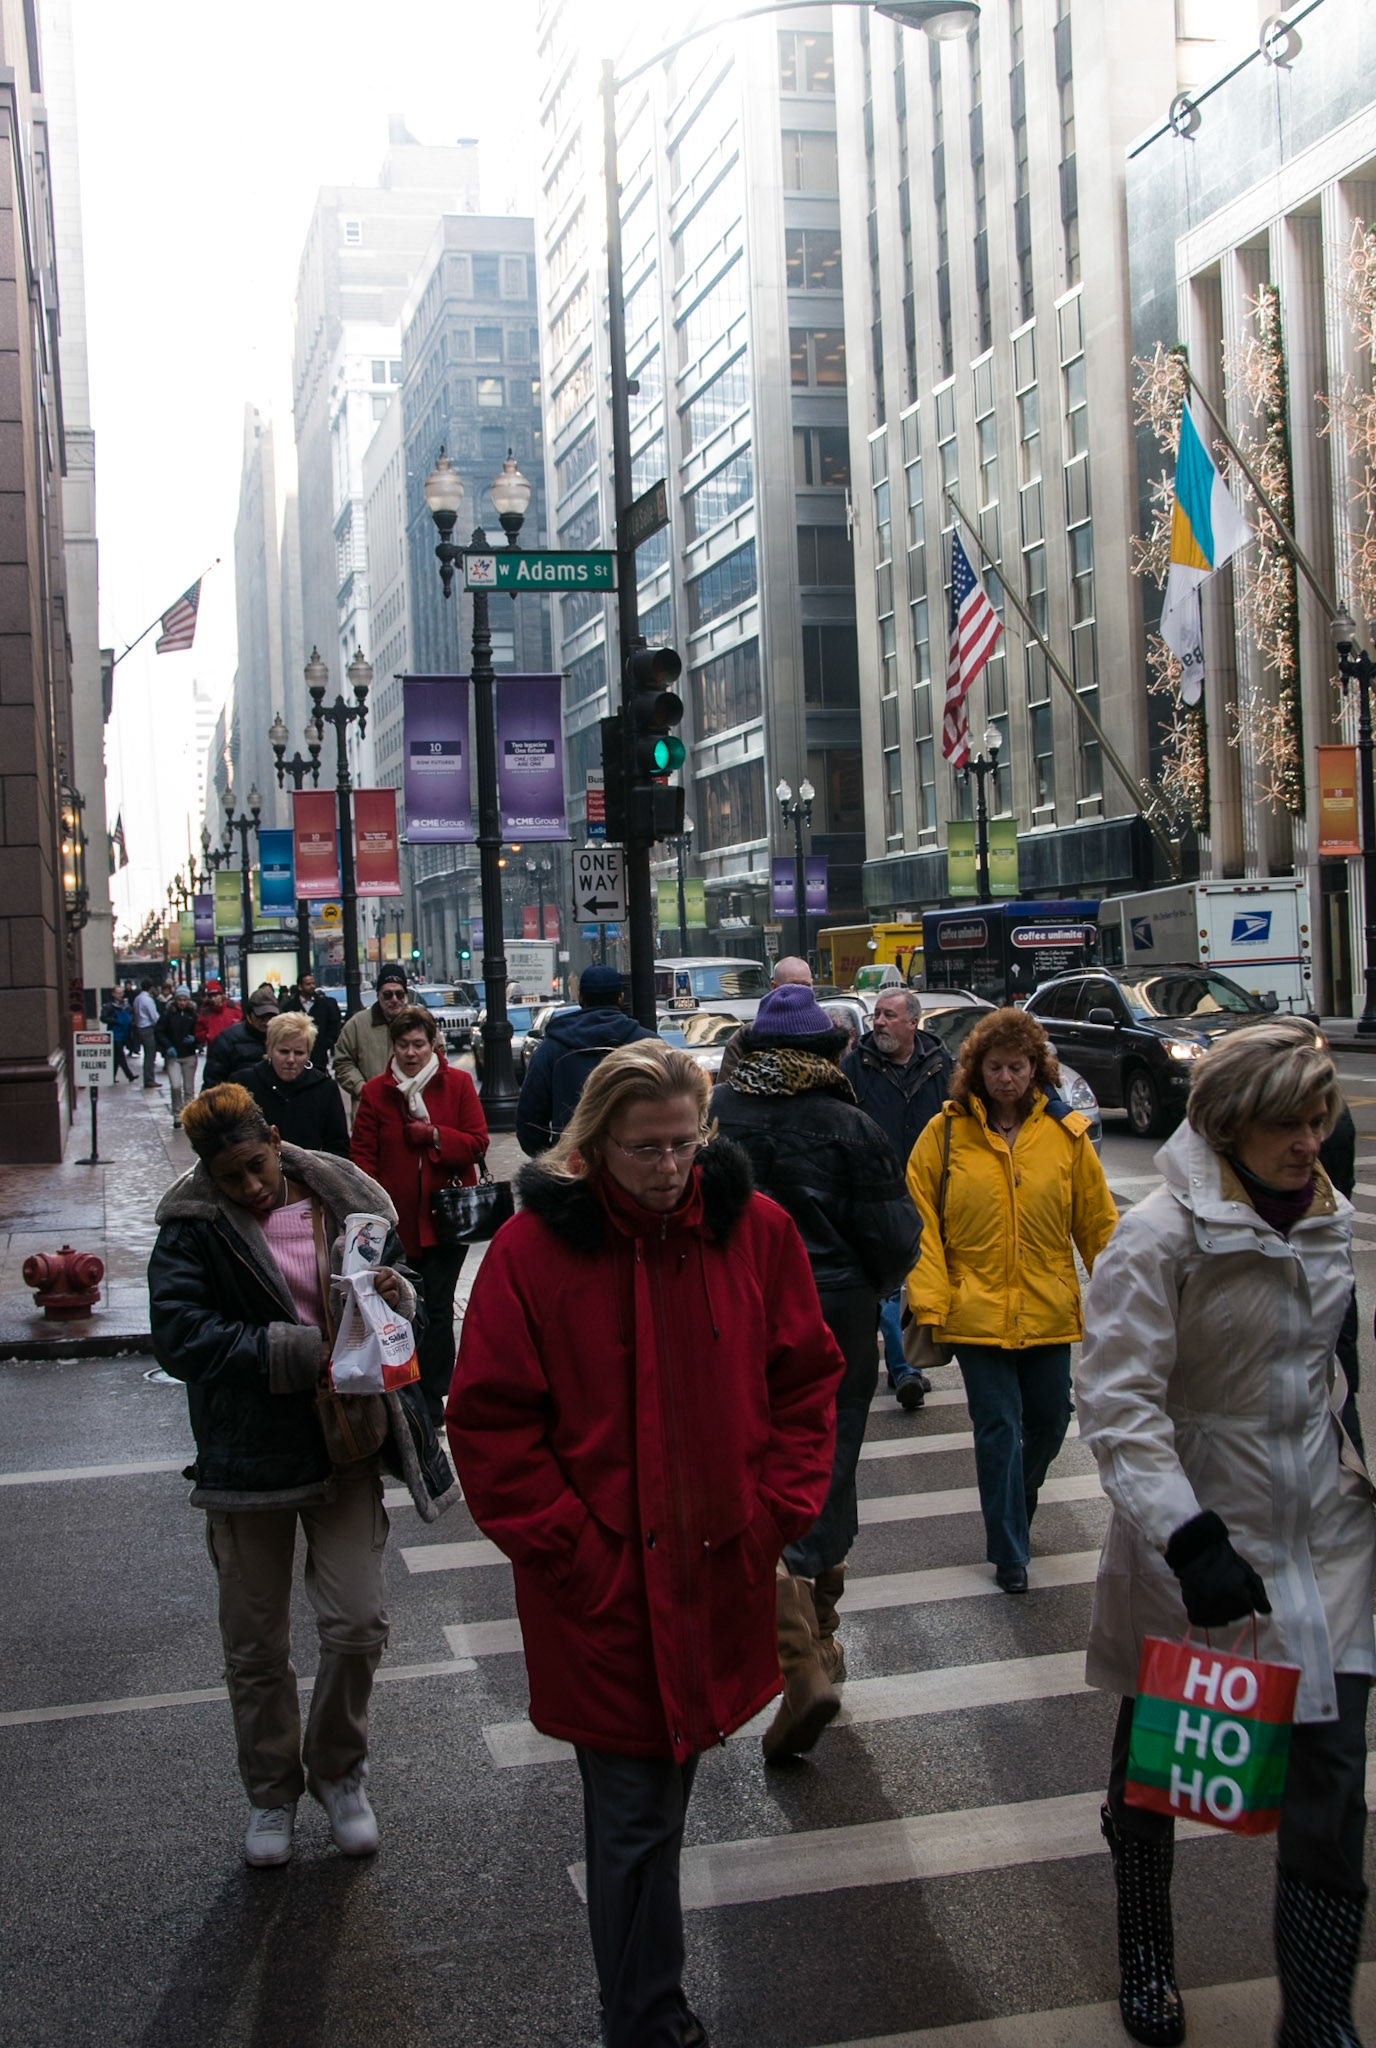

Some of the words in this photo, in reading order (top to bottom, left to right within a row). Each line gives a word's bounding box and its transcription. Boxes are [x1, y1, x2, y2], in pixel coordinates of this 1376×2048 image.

[517, 560, 588, 581] Adams
[594, 566, 608, 576] St
[430, 743, 441, 751] 10
[420, 819, 439, 827] CME
[535, 818, 559, 826] Group
[580, 855, 617, 871] ONE
[579, 875, 618, 891] WAY
[1018, 931, 1046, 940] coffee
[1048, 930, 1083, 939] unlimite
[77, 1049, 98, 1057] WATCH
[99, 1049, 111, 1057] FOR
[81, 1061, 106, 1069] FALLING
[89, 1073, 99, 1081] ICE
[1183, 1656, 1258, 1712] HO
[1174, 1709, 1250, 1767] HO
[1169, 1763, 1244, 1822] HO
